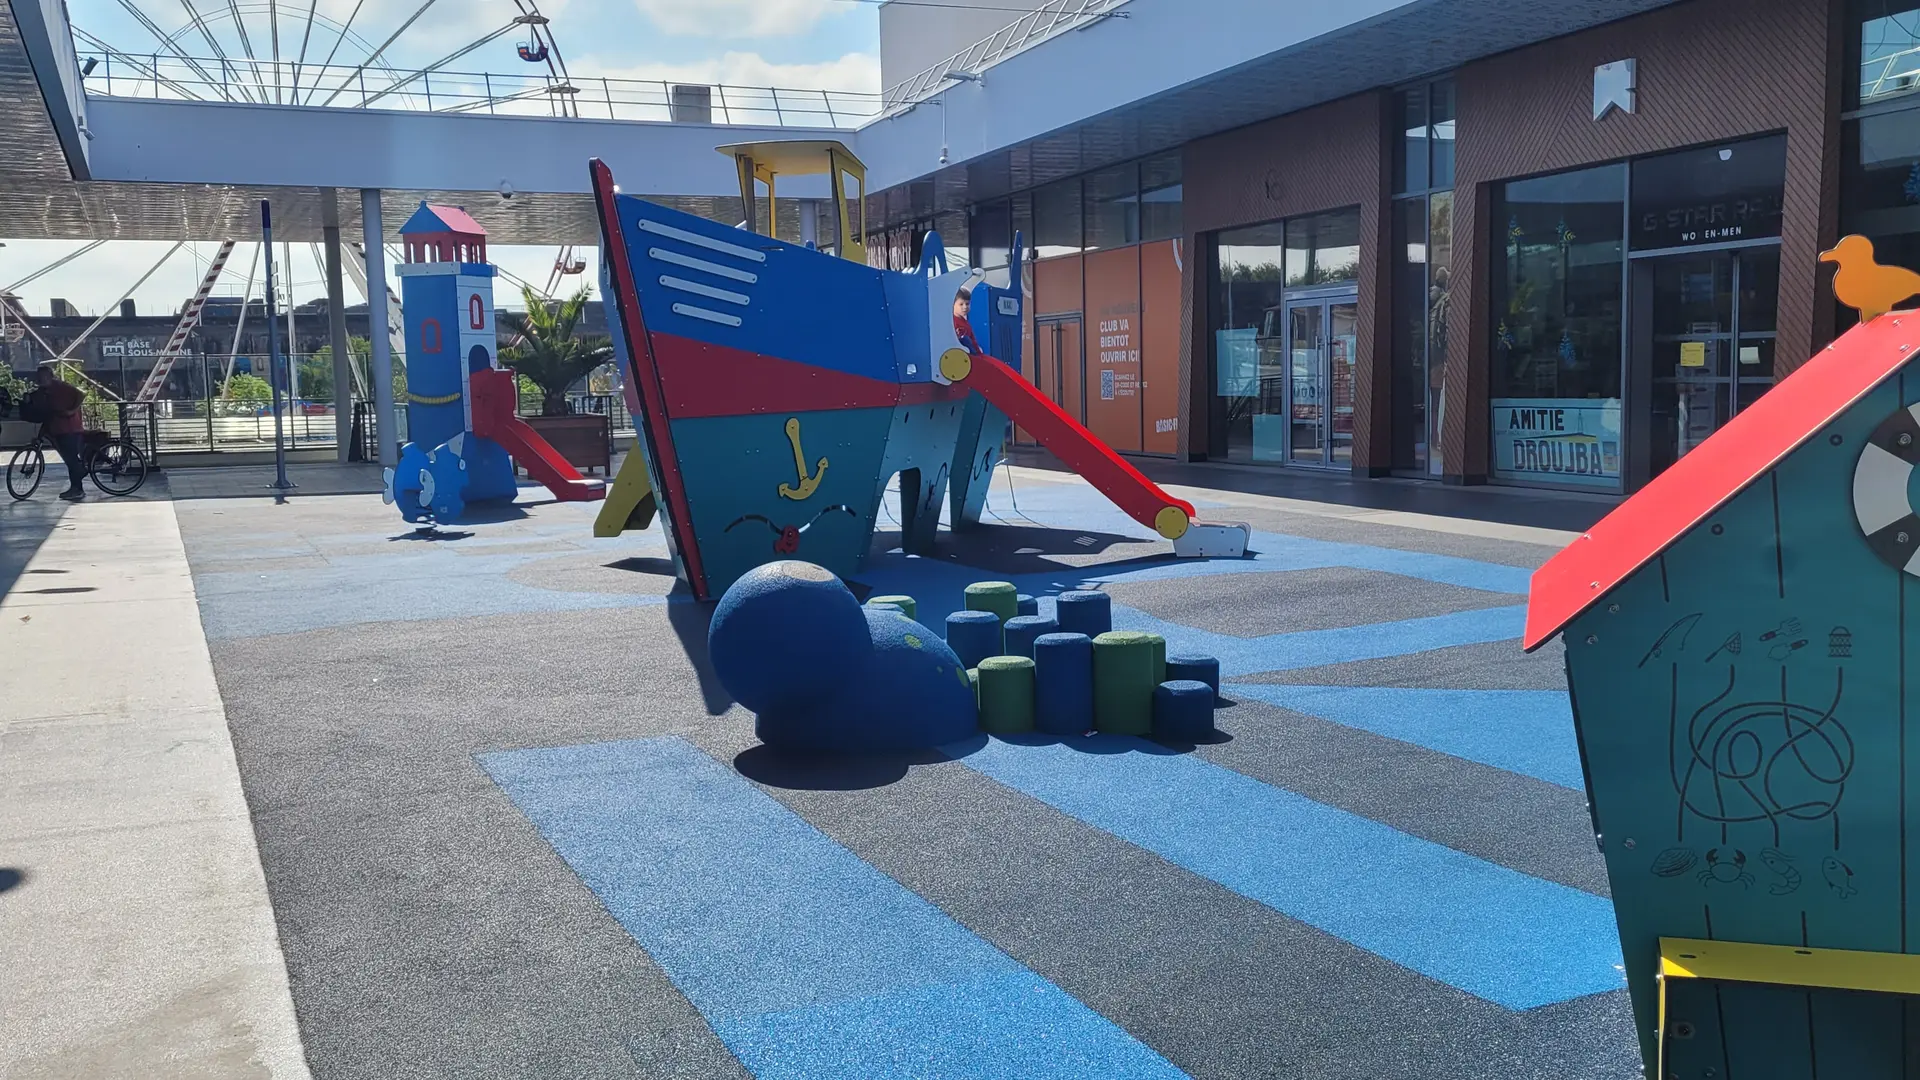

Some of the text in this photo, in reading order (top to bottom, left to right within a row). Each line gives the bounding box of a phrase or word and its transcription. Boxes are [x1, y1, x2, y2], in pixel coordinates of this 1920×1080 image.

[1100, 318, 1129, 333] CLUB VA
[1100, 351, 1127, 363] OUVRIR
[1509, 409, 1565, 431] AMITIE
[1513, 440, 1603, 475] DROUJBA
